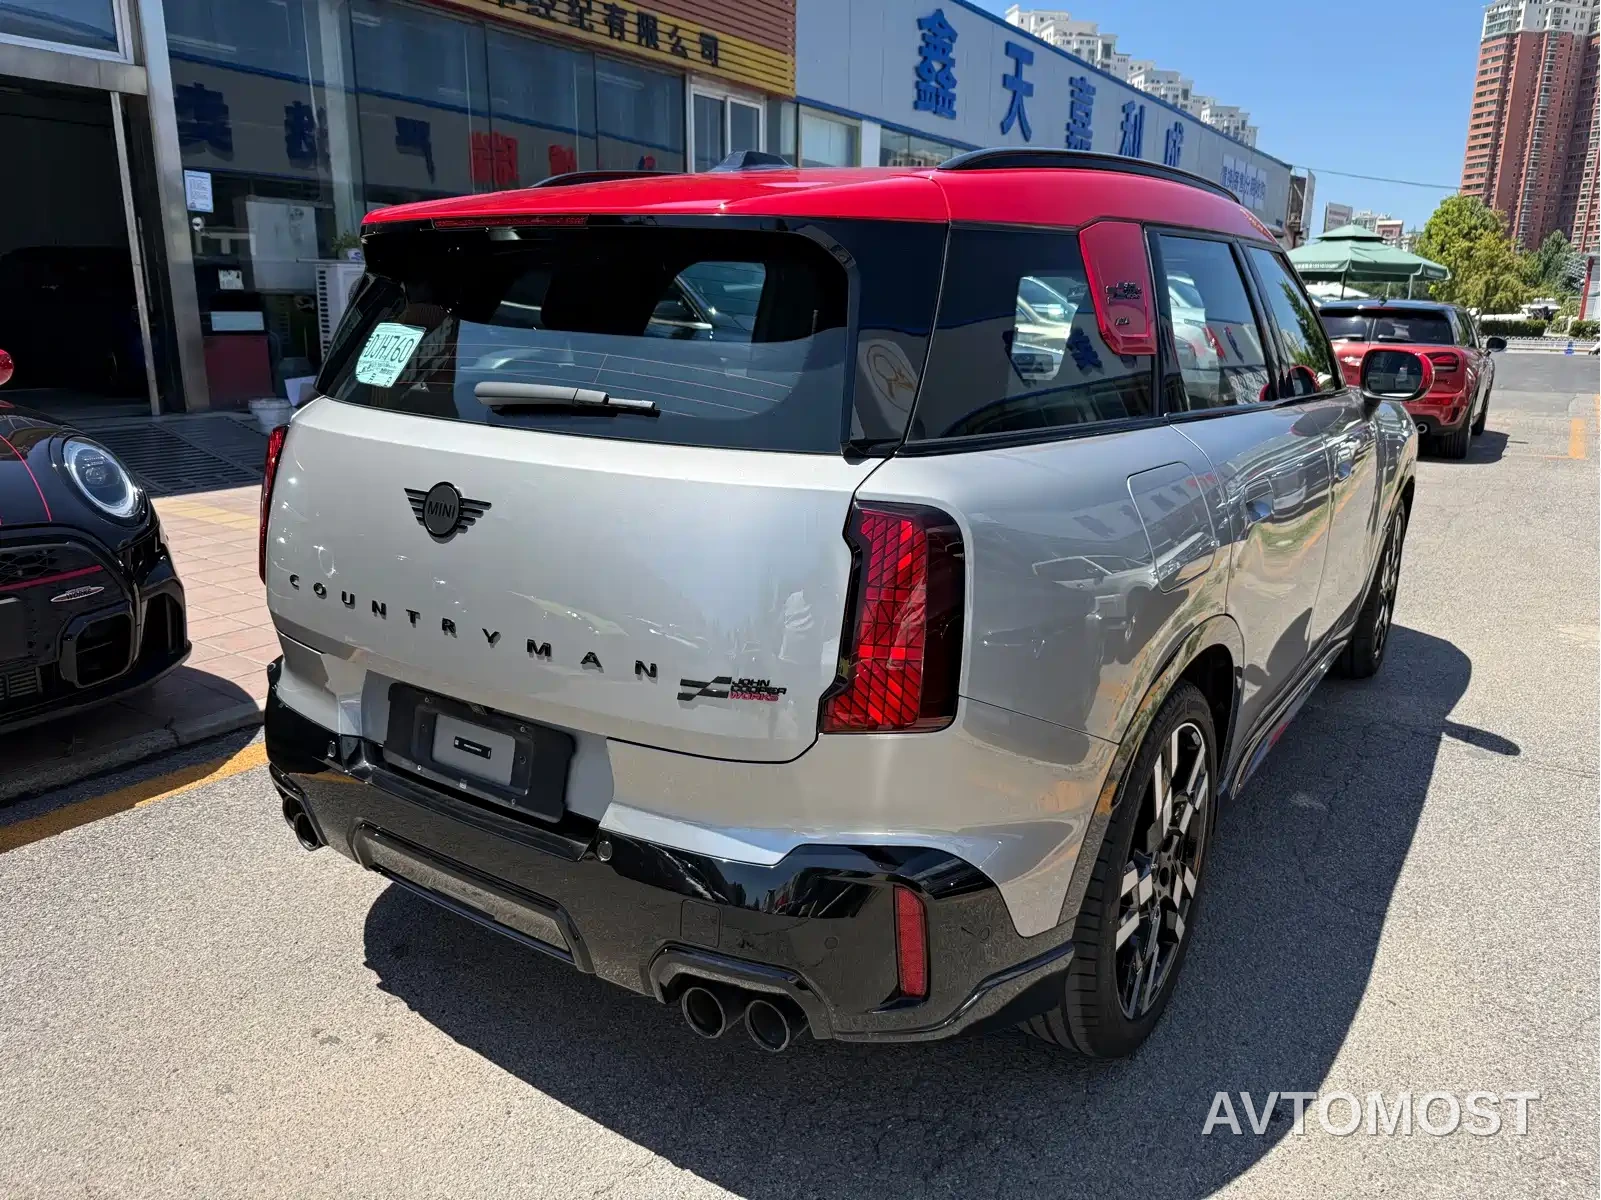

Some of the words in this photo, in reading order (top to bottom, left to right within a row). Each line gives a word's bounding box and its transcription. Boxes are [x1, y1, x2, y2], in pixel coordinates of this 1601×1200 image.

[499, 0, 719, 67] 经纪有限公司
[428, 500, 456, 519] MINI
[289, 574, 658, 677] COUNTRYMAN
[732, 678, 771, 687] JOHN
[729, 691, 780, 701] WORKS
[730, 685, 787, 695] COOPER
